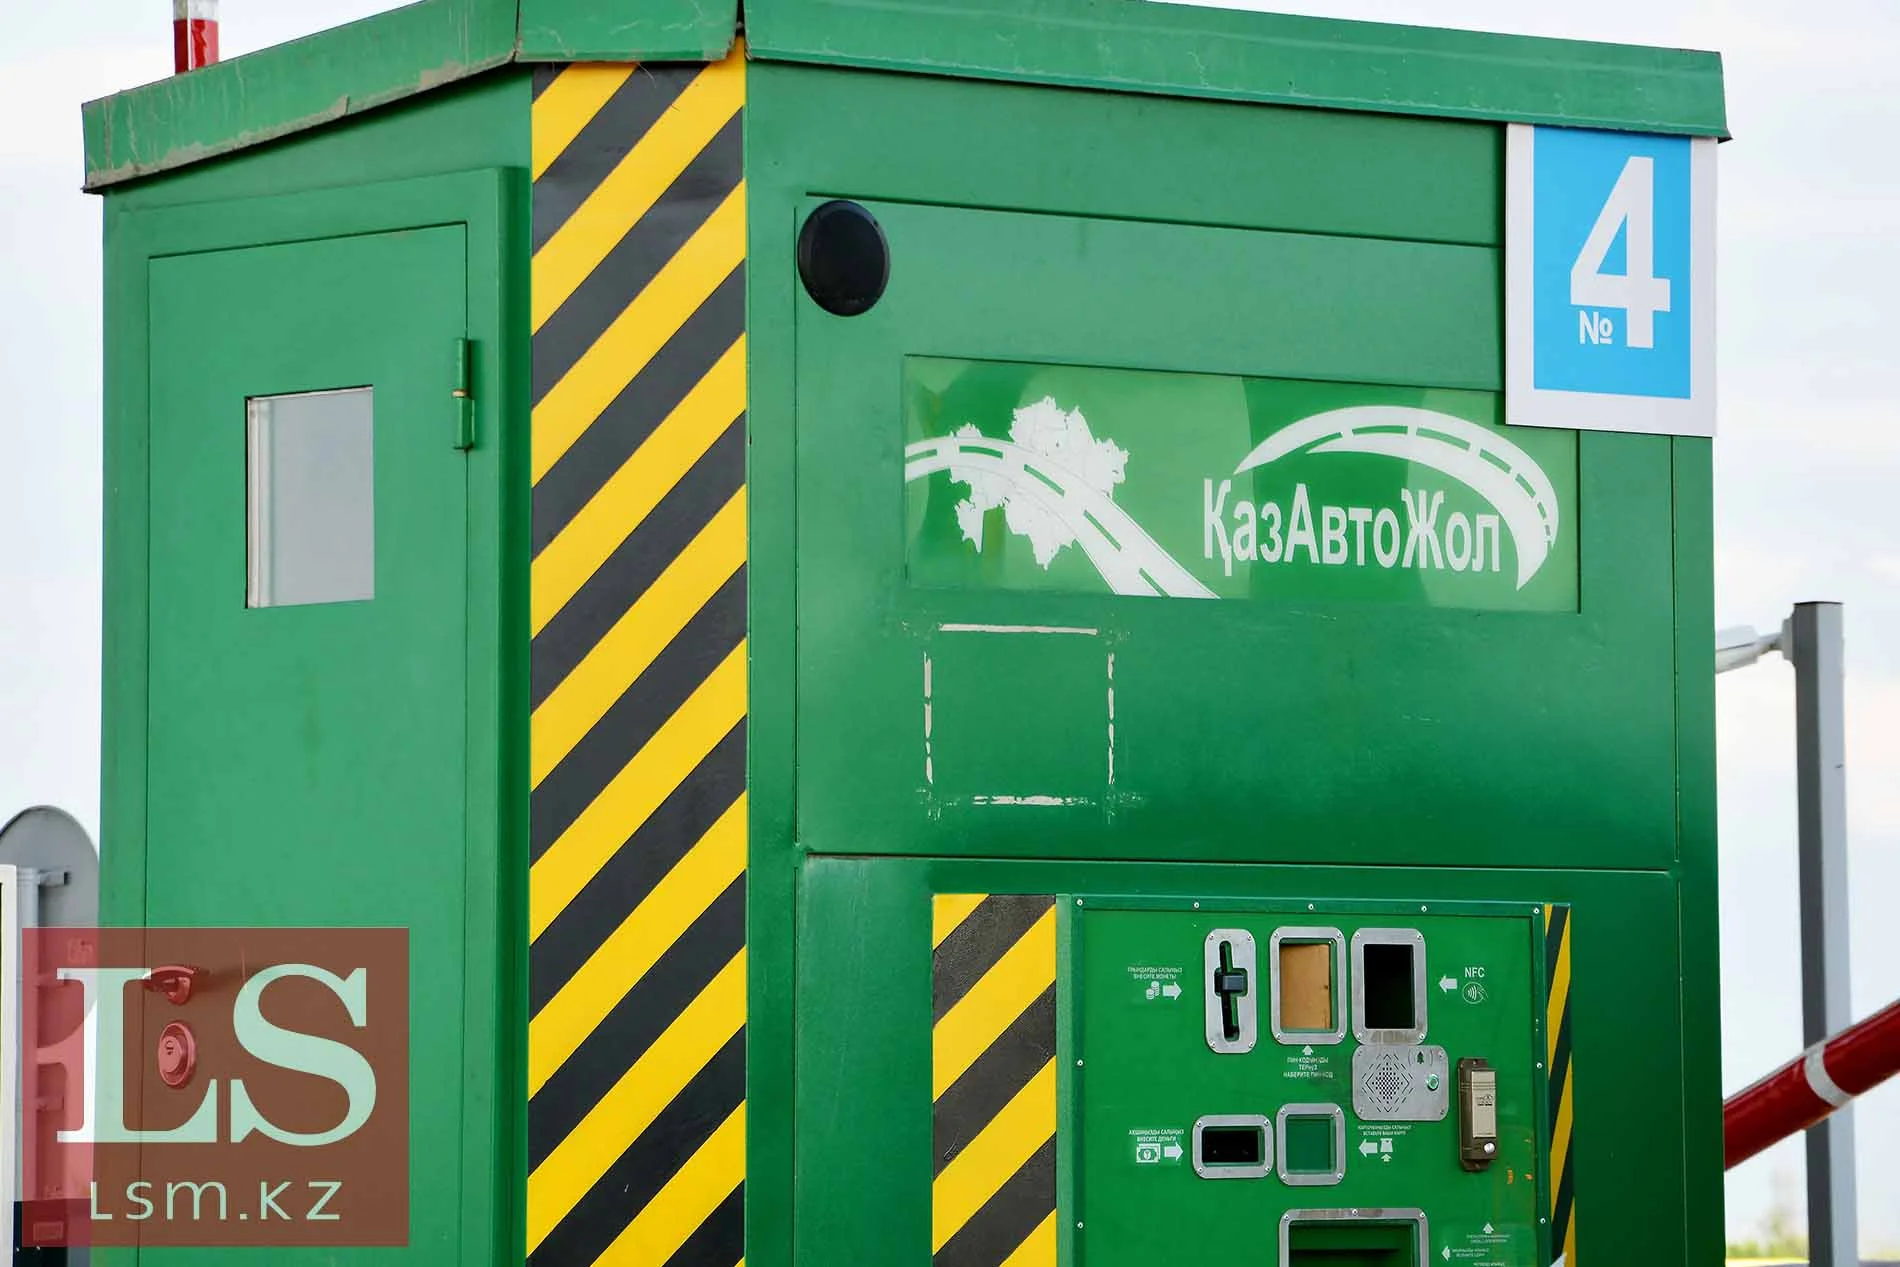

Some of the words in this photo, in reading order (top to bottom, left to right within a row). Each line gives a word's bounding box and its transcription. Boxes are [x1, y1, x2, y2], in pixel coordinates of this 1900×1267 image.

[1570, 156, 1671, 349] 4
[1203, 477, 1501, 577] ҚазАвтоЖол
[1464, 966, 1486, 978] NFC
